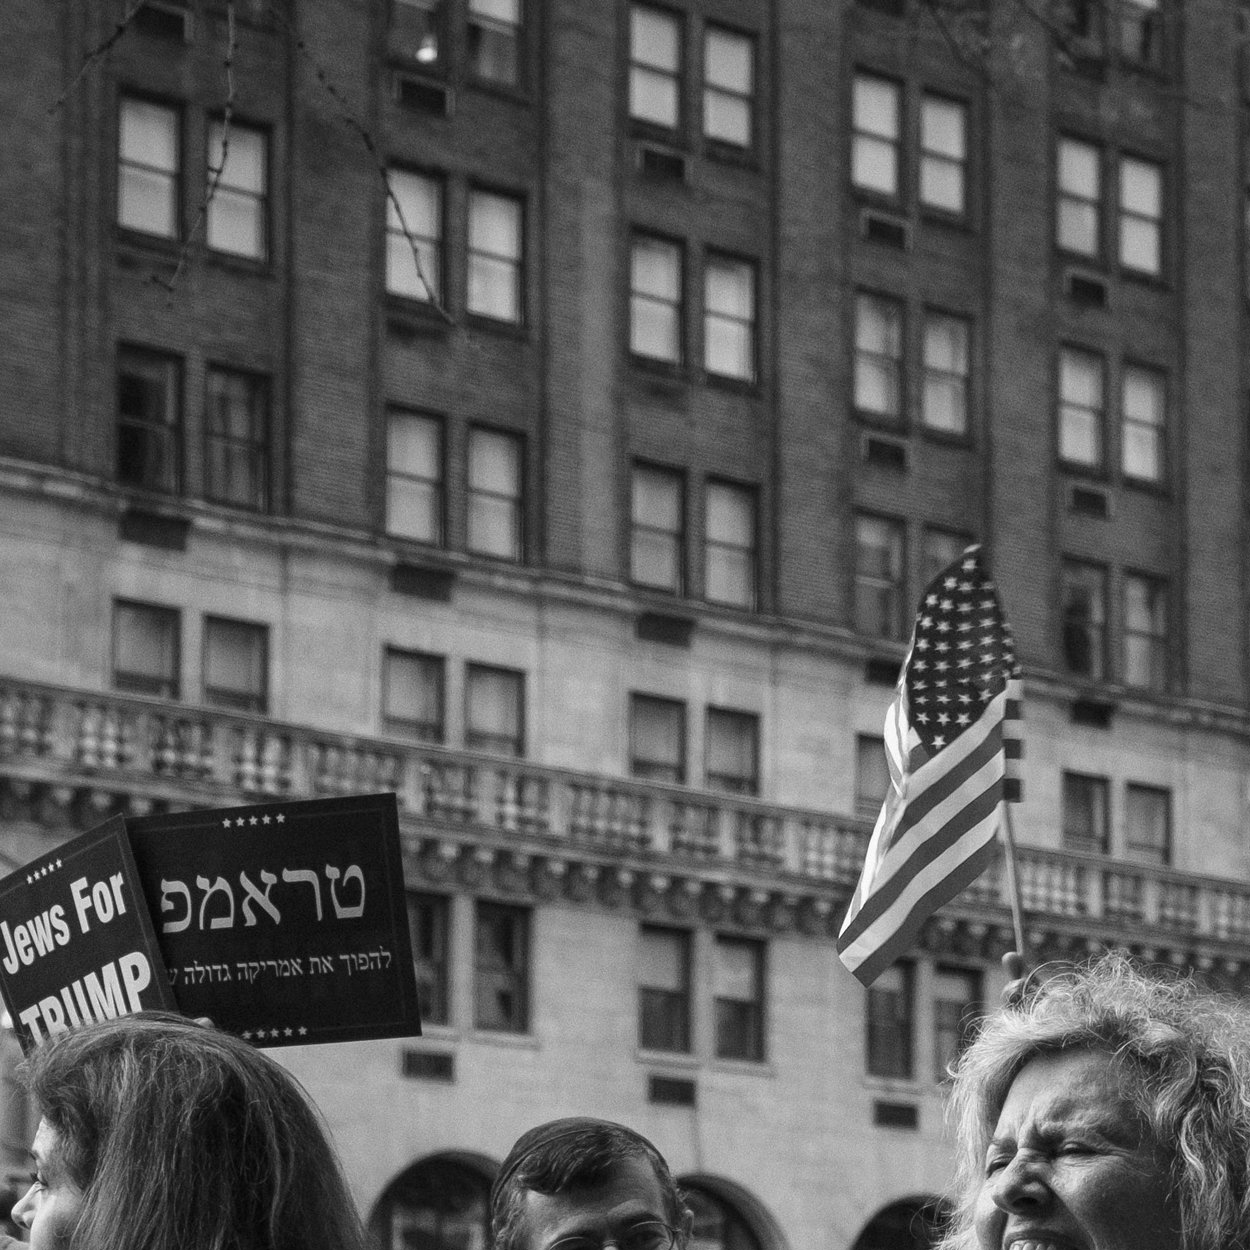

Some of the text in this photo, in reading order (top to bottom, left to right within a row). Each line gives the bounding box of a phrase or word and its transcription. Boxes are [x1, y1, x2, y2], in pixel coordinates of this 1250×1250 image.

[160, 863, 366, 934] טראמפ
[0, 871, 126, 975] Jews For
[184, 960, 231, 984] גדולה
[236, 959, 303, 984] אמריקה
[309, 956, 334, 974] את
[339, 944, 392, 976] להפוך
[18, 951, 151, 1048] TRUMP
